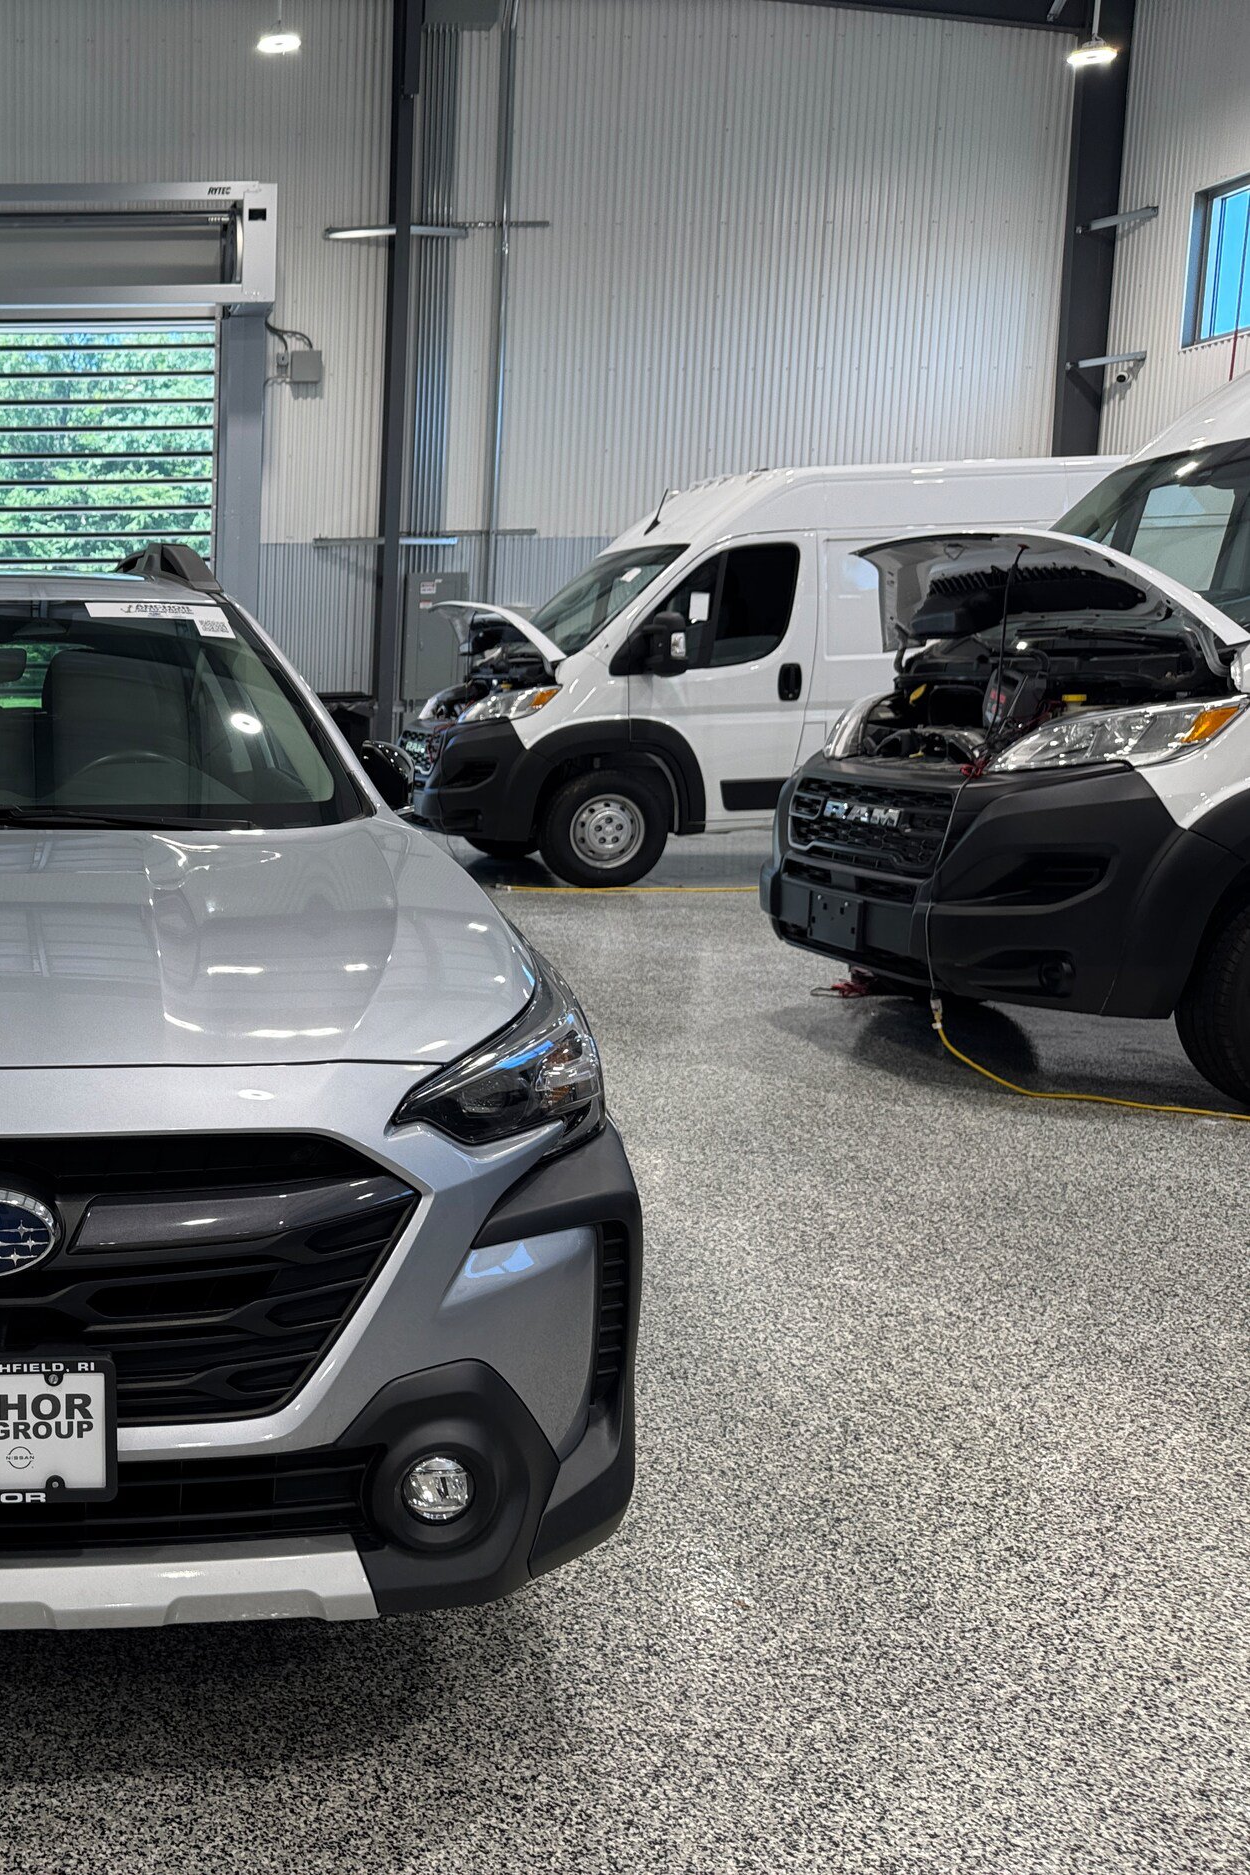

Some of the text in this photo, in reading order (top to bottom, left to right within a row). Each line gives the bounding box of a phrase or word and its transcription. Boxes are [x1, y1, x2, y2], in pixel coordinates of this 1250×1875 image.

[208, 186, 231, 195] RYTEC
[823, 800, 901, 827] RAM
[77, 1362, 95, 1372] RI
